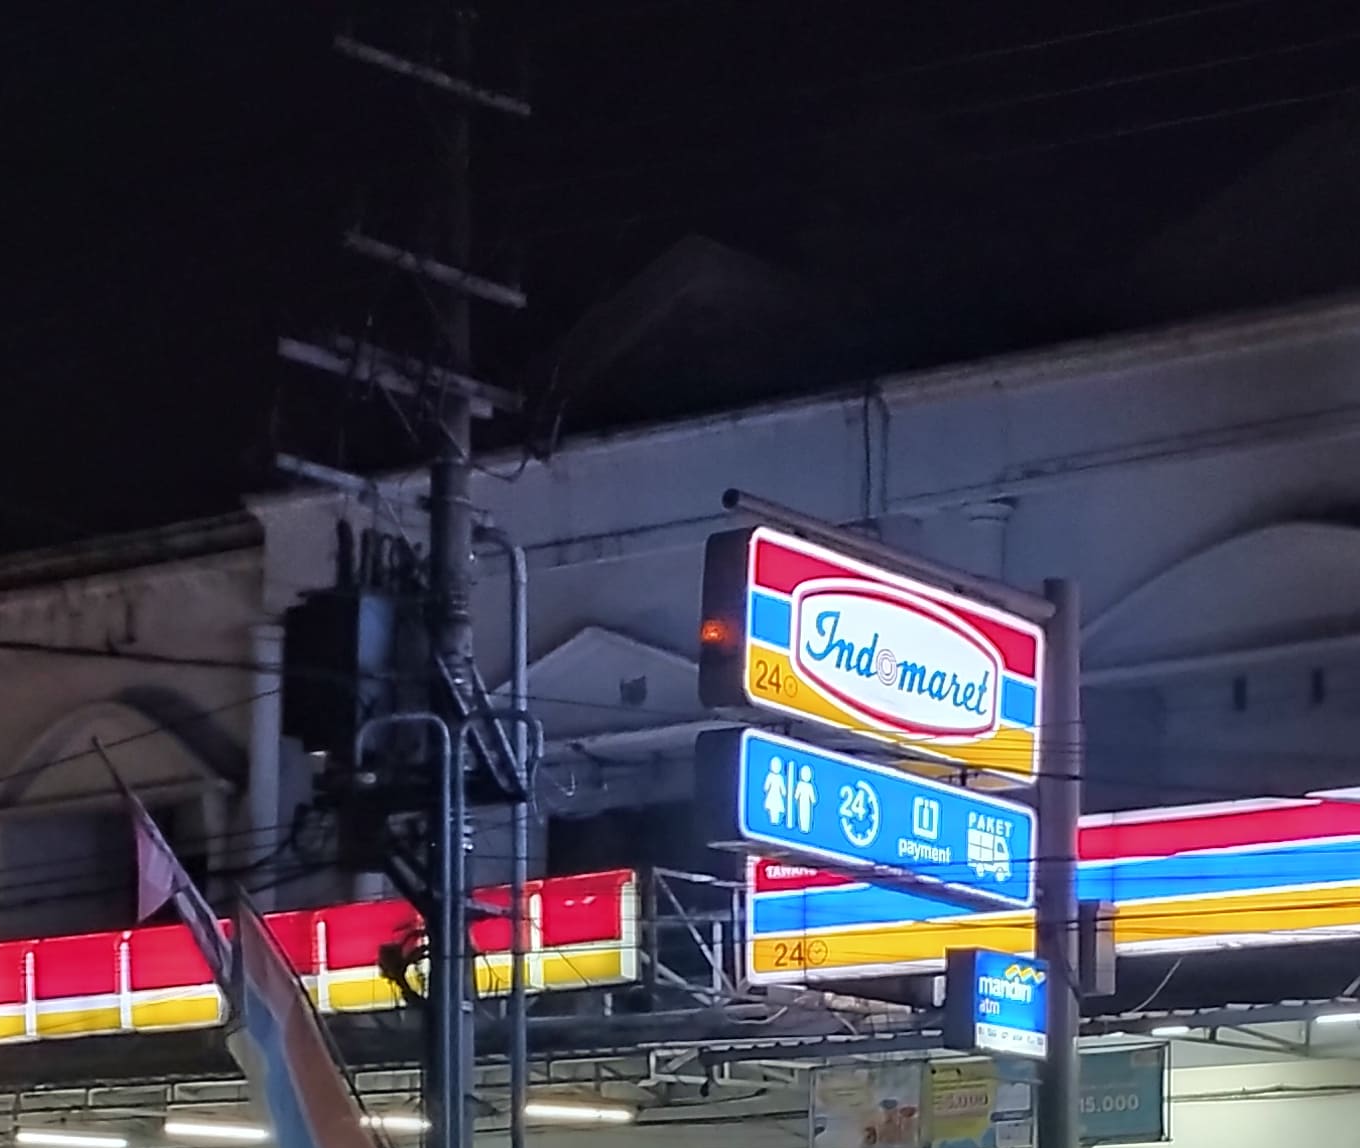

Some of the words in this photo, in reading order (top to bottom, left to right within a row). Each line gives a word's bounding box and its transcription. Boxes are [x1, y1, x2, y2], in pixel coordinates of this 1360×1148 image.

[755, 660, 782, 694] 24
[806, 610, 990, 715] Indomaret
[839, 785, 866, 821] 24
[968, 811, 1012, 837] PAKET
[898, 838, 951, 864] payment
[774, 941, 805, 967] 24
